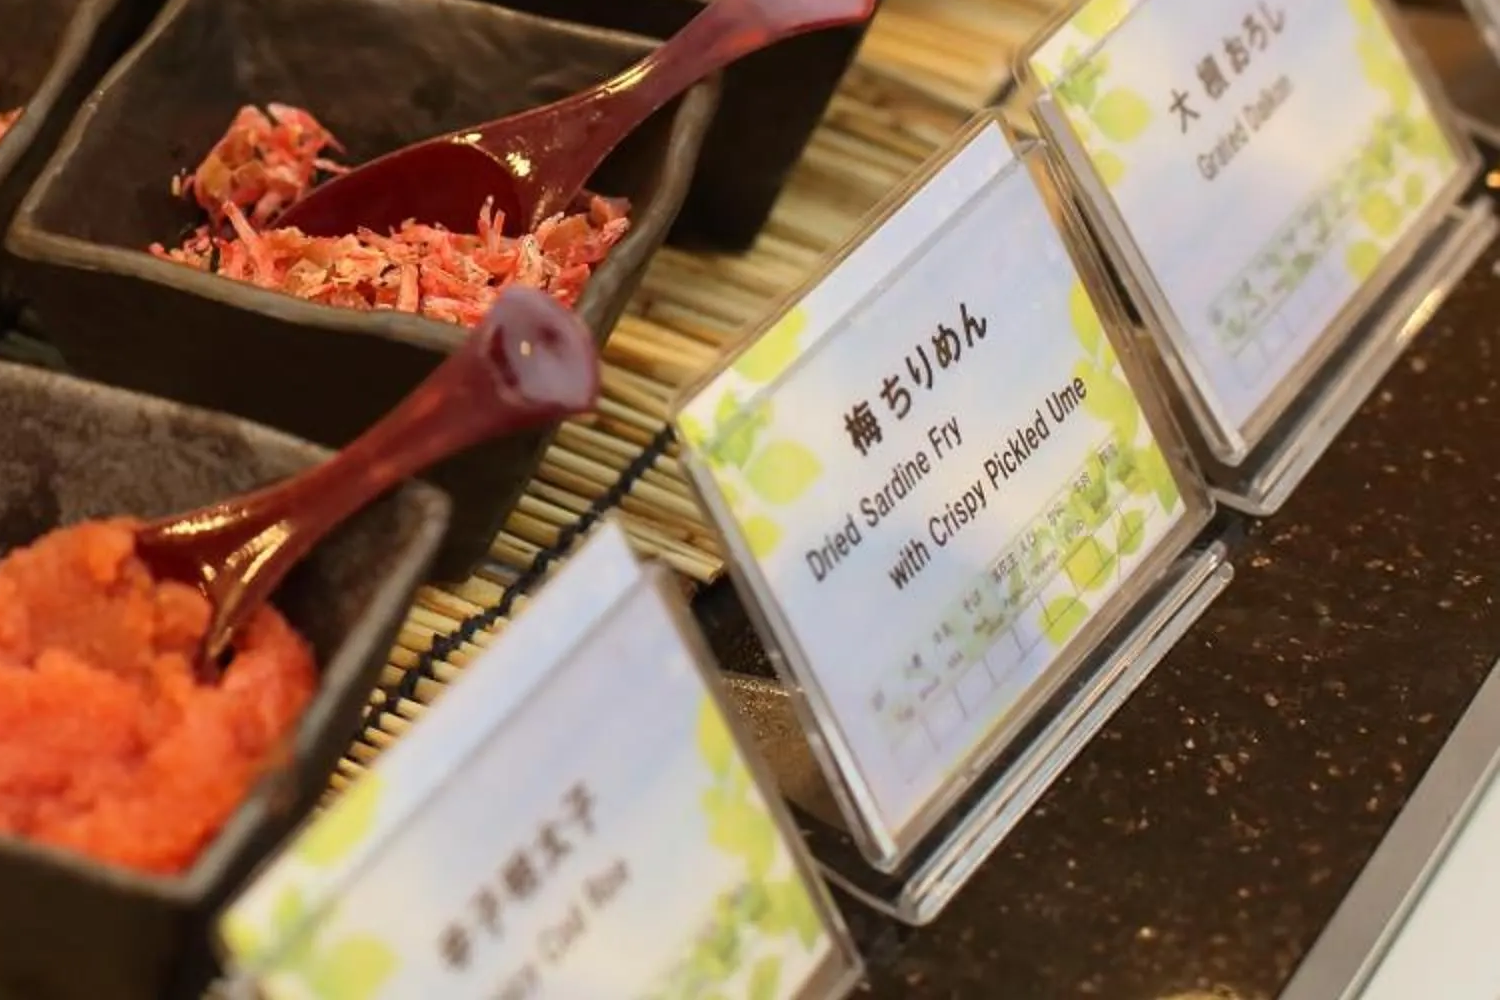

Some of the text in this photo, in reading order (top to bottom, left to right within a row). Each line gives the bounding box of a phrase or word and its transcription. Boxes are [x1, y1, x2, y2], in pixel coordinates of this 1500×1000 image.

[843, 302, 988, 457] 梅ちりめん
[805, 415, 963, 583] Dried Sardine Fry
[888, 537, 932, 590] with
[928, 478, 987, 549] Crispy
[983, 408, 1051, 490] Pickled
[1046, 376, 1088, 424] Ume
